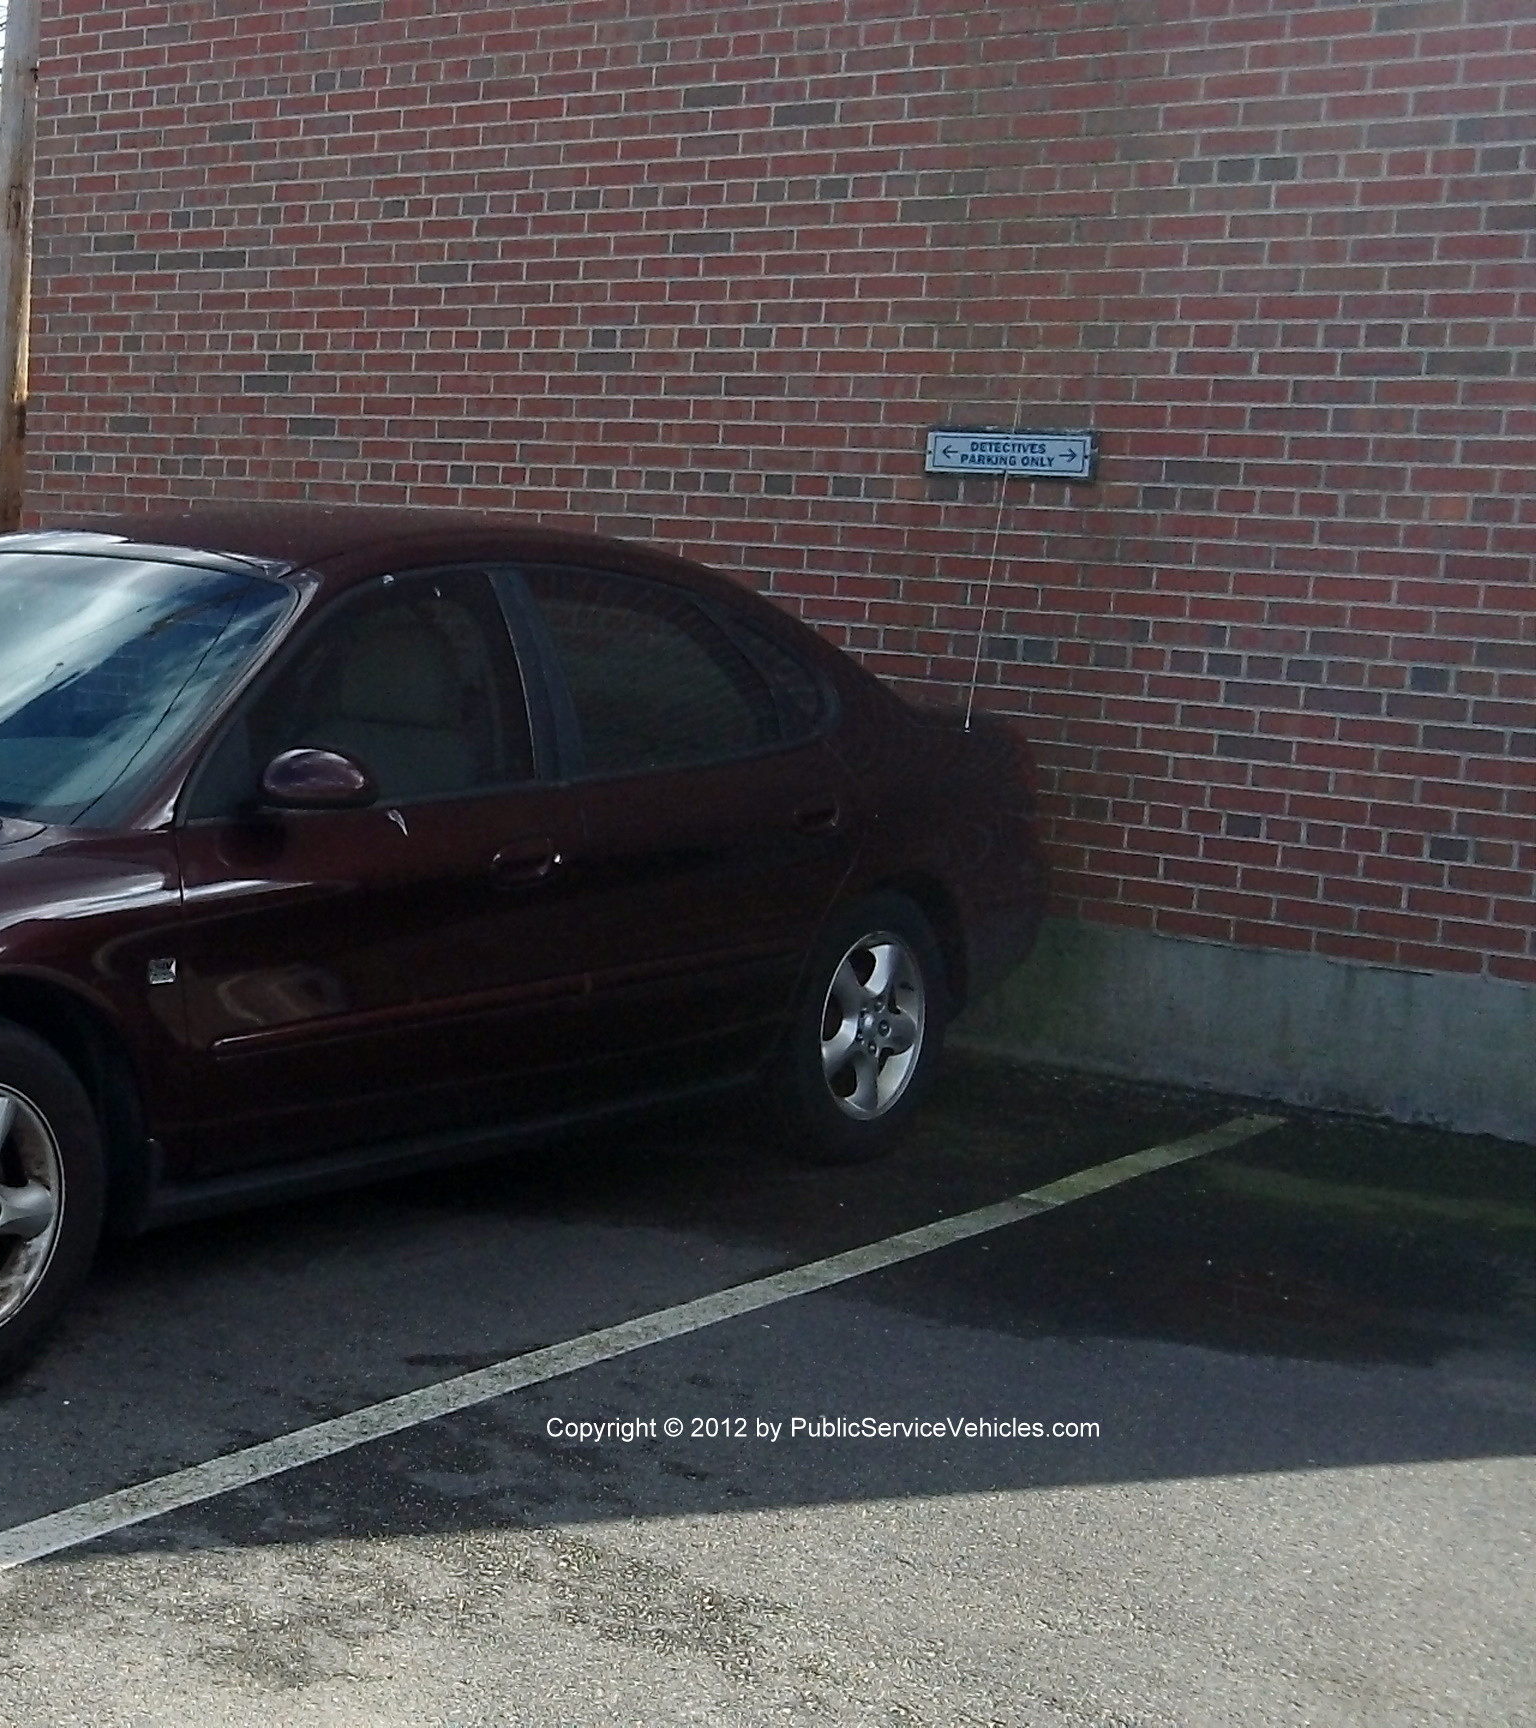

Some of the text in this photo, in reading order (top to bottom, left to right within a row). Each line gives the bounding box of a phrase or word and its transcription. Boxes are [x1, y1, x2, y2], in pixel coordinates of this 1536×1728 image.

[970, 441, 1047, 454] DETECTIVES
[960, 454, 1055, 468] PARKING ONLY
